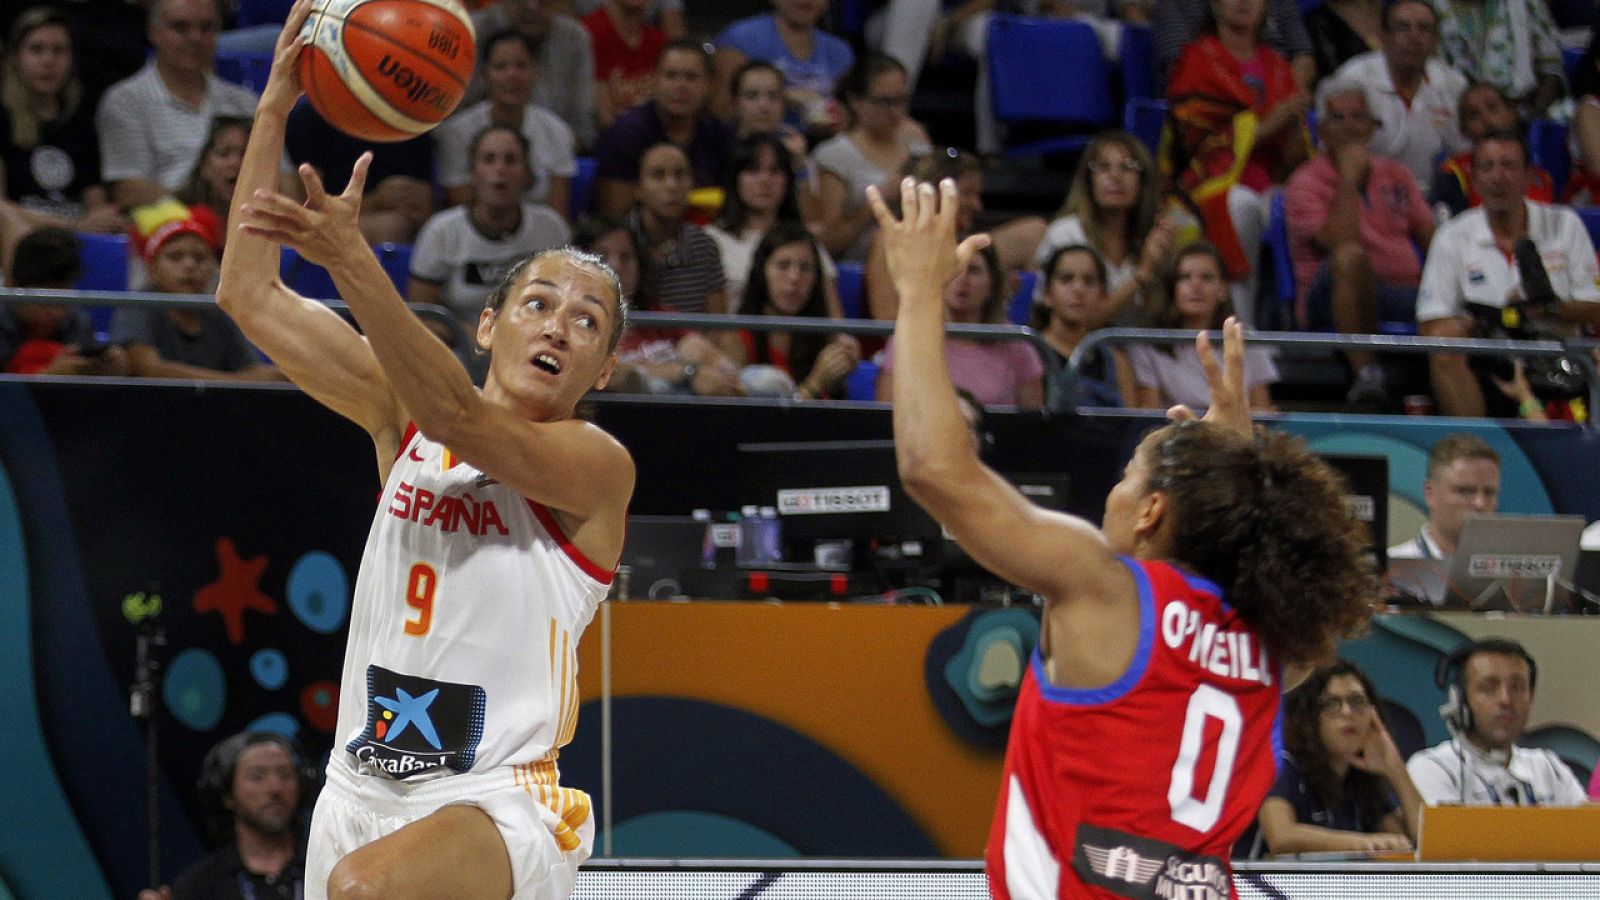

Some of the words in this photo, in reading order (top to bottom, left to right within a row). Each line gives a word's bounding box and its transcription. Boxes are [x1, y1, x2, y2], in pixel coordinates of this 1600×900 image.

[377, 53, 455, 111] molten
[388, 480, 510, 536] SPAÑA
[403, 561, 438, 638] 9
[1167, 683, 1244, 834] 0
